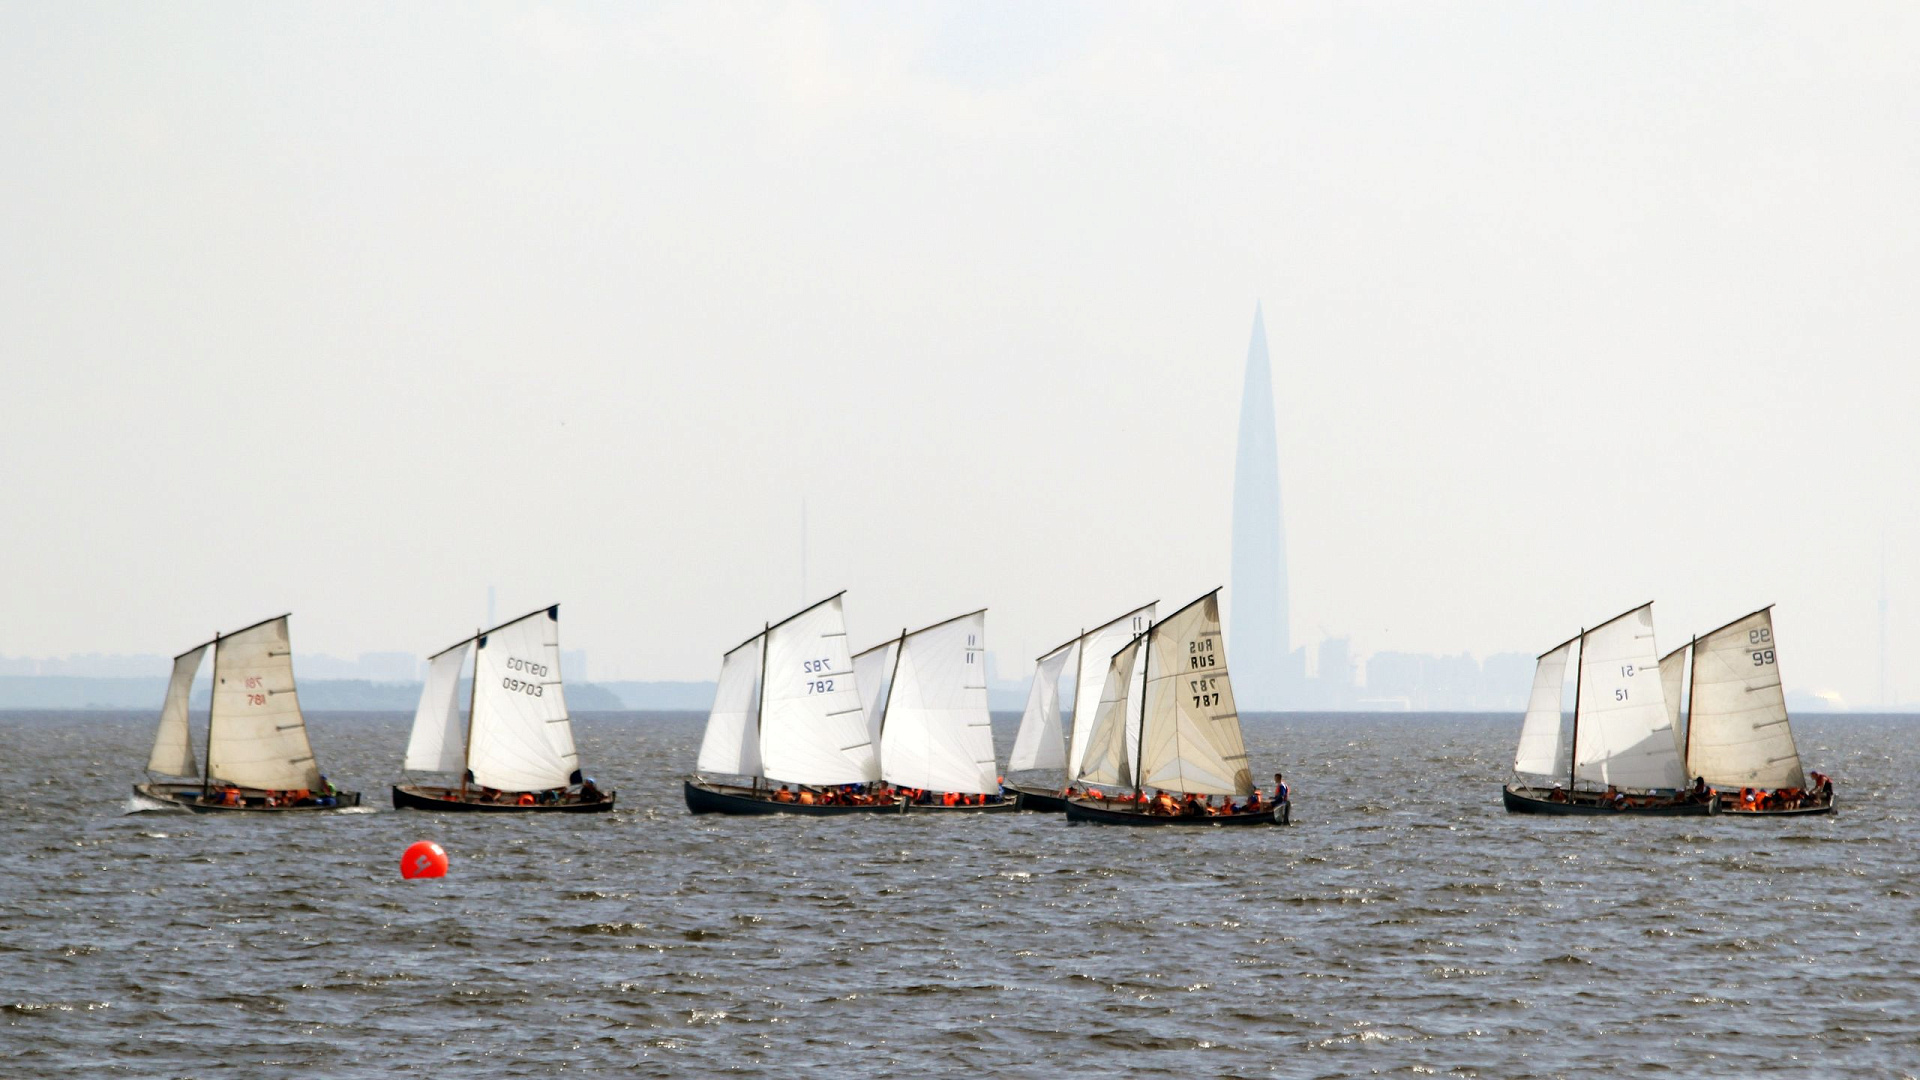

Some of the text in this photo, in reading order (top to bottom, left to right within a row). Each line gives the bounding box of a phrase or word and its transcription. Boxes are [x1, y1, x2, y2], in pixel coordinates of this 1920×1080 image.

[966, 652, 974, 664] 11
[1191, 654, 1215, 670] RUS
[1752, 650, 1775, 667] 99
[502, 677, 543, 697] 09703
[806, 680, 834, 695] 782
[247, 694, 266, 706] 781
[1193, 693, 1219, 709] 787
[1615, 689, 1628, 702] 51
